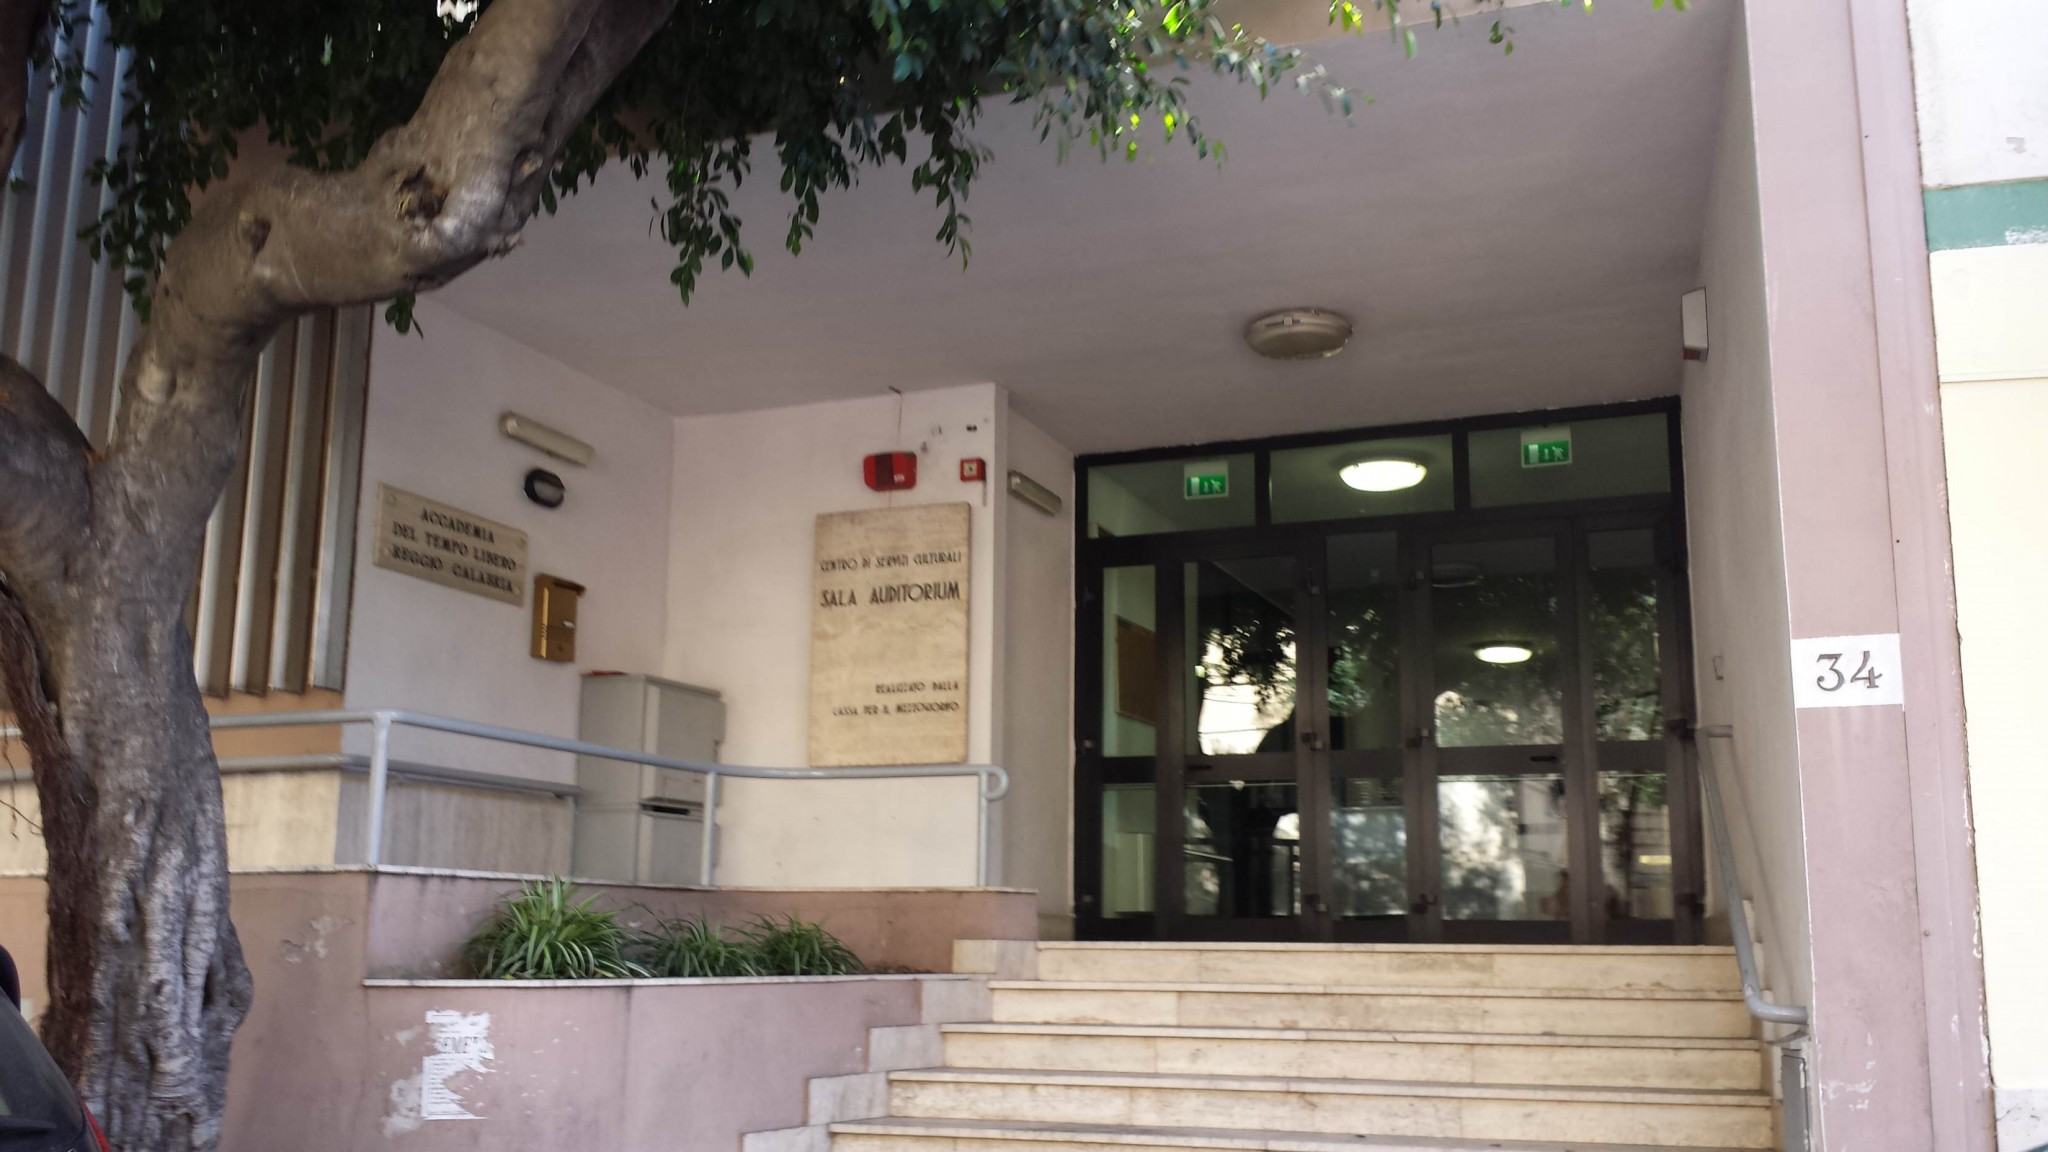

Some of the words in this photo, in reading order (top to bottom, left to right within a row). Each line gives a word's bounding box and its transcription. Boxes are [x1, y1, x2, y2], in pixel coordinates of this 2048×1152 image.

[420, 507, 495, 543] ACCADEMIA
[392, 521, 417, 541] DEL
[424, 531, 469, 556] TEMPO
[473, 547, 517, 571] LIBERO
[820, 558, 858, 572] CENTRO
[875, 553, 909, 568] SERVIZI
[913, 550, 962, 565] CULTURALI
[391, 544, 444, 570] REGGIO
[452, 562, 513, 592] CALABRIA
[820, 587, 857, 608] SALA
[869, 580, 961, 605] AUDITORIUM
[1816, 650, 1883, 692] 34
